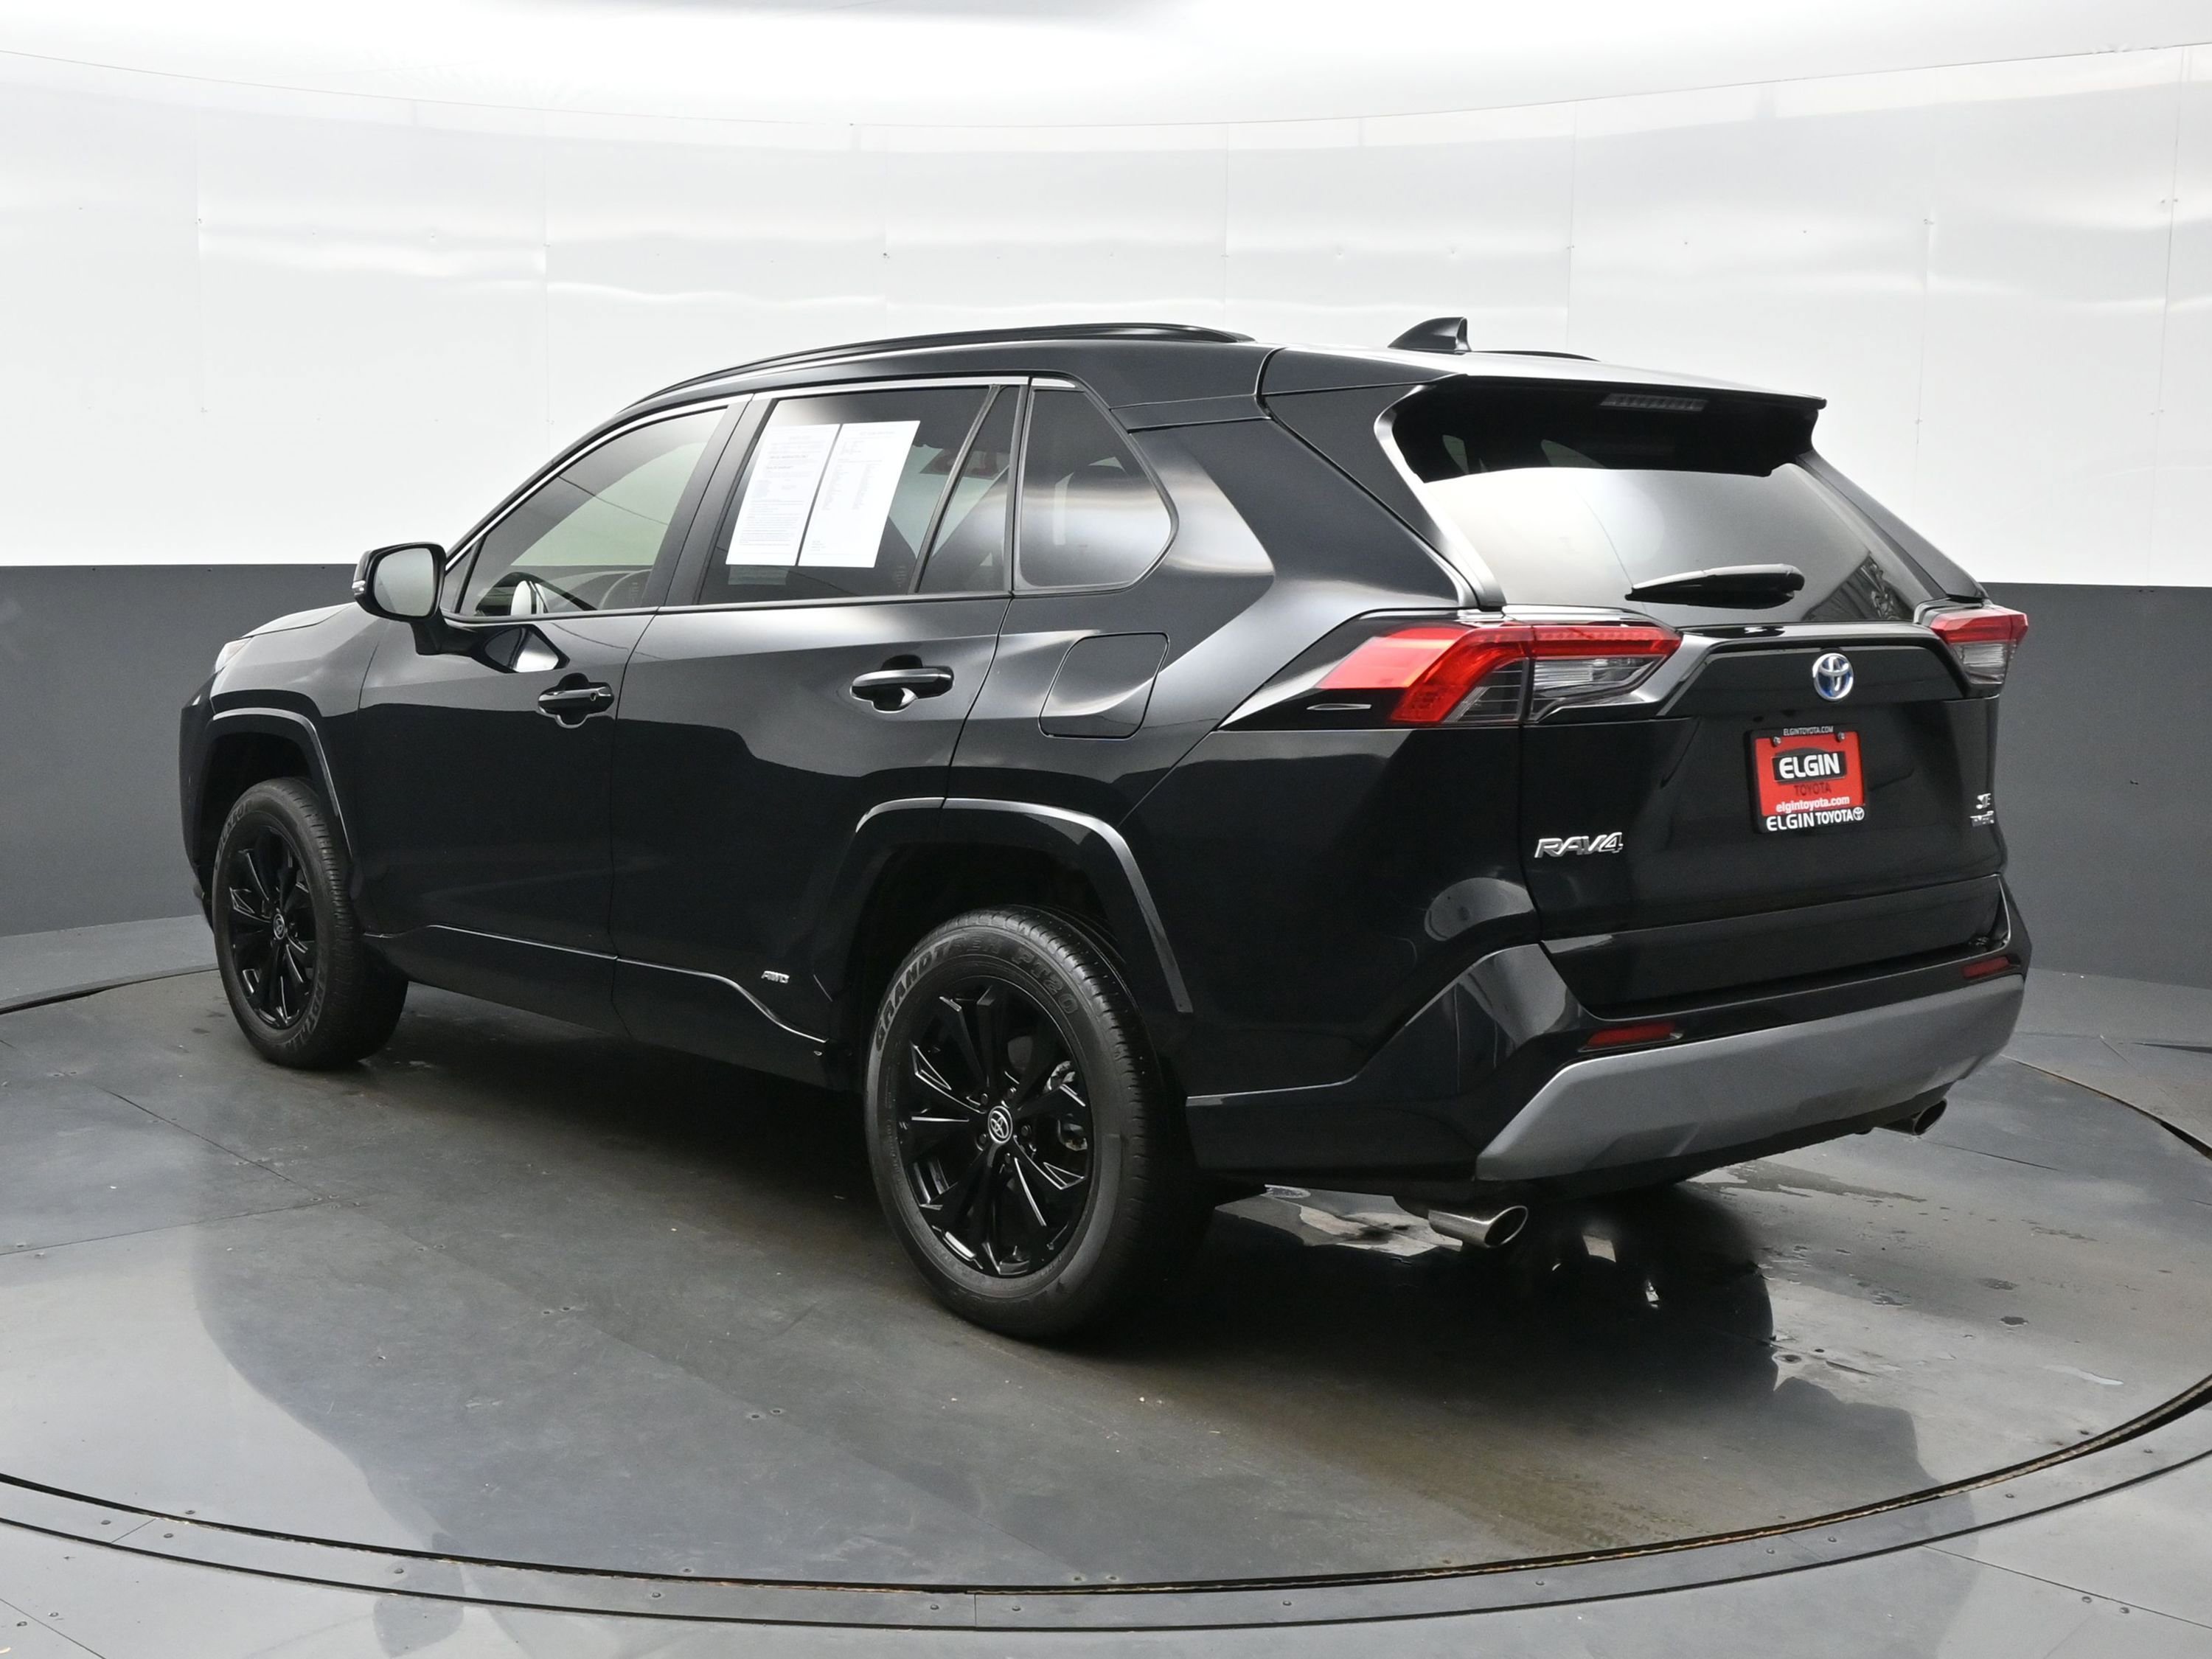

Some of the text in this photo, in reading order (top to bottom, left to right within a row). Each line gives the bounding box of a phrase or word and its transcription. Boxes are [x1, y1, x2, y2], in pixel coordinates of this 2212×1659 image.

[1783, 726, 1834, 736] ELGINTOYOTA.COM
[1778, 753, 1840, 779] ELGIN
[1793, 782, 1832, 796] TOYOTA
[1775, 796, 1851, 814] elgintoyota.com
[1766, 809, 1854, 832] ELGIN TOYOTA
[1534, 832, 1624, 858] RAV4
[1011, 947, 1079, 1015] PT20
